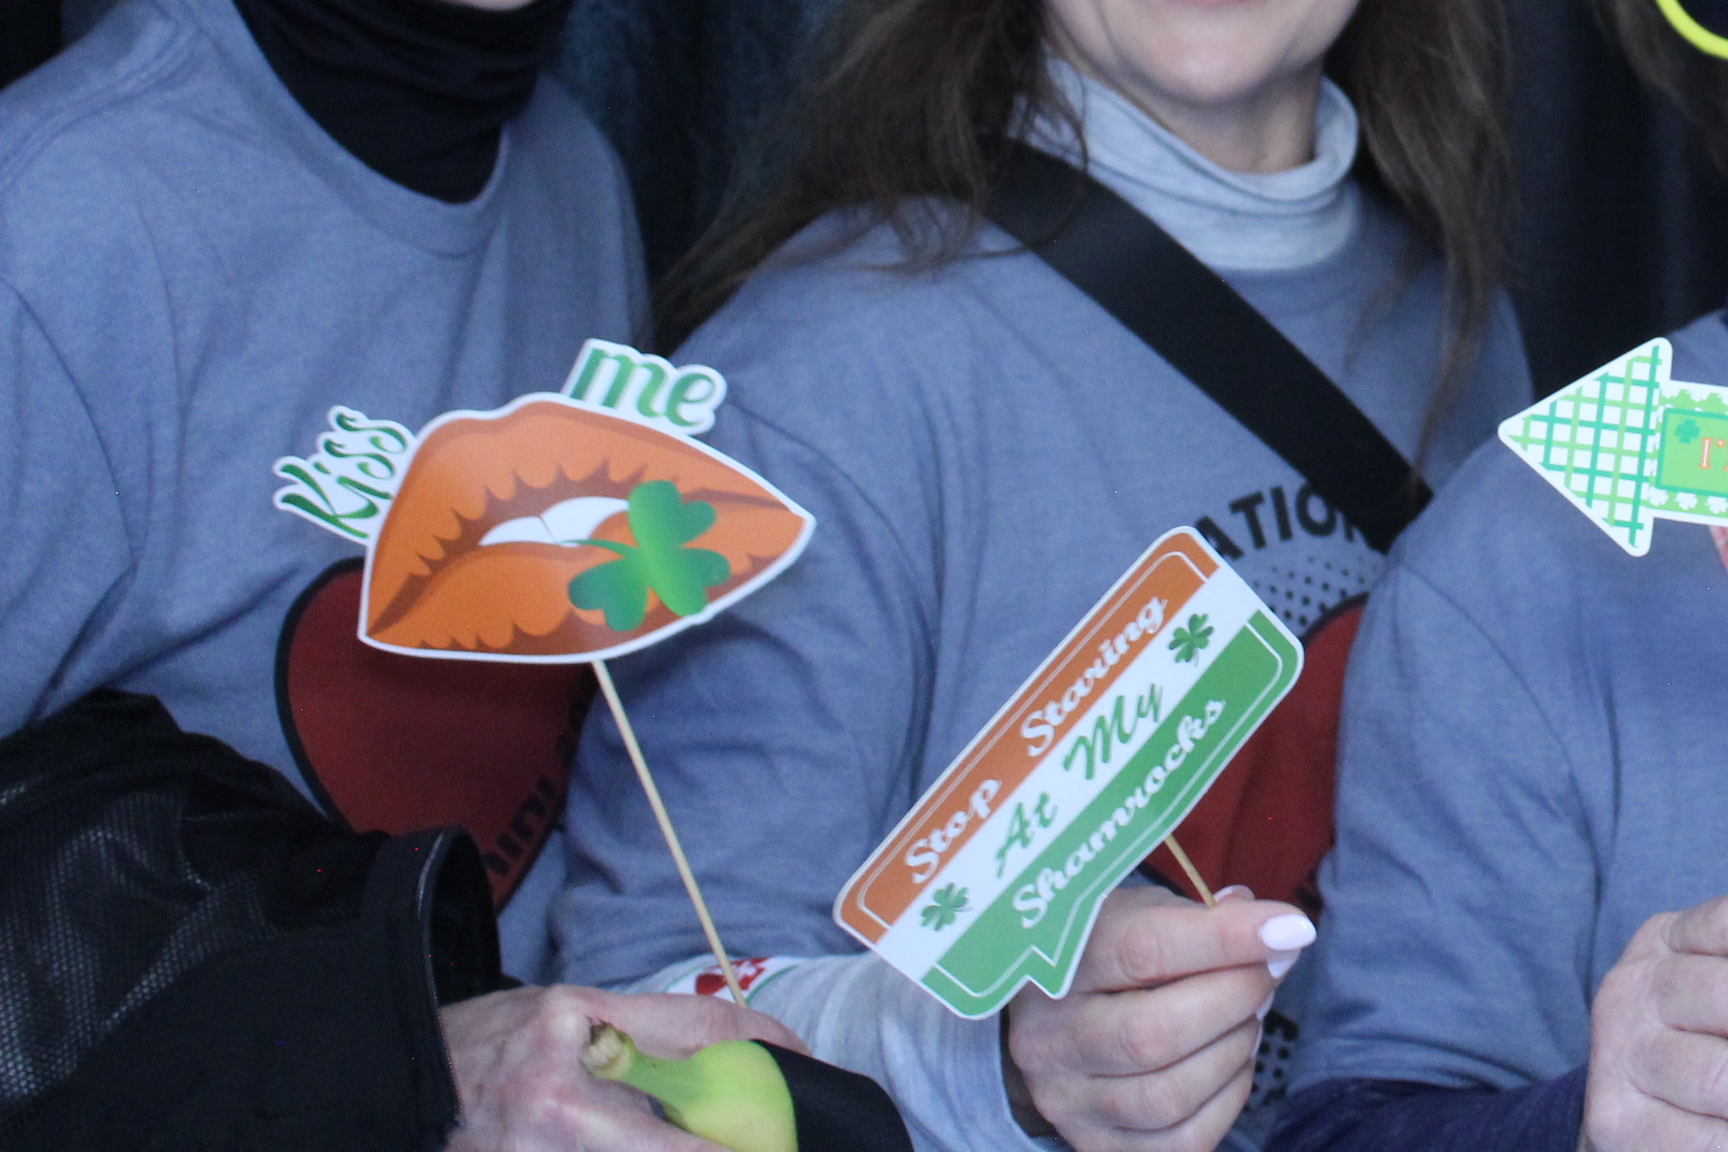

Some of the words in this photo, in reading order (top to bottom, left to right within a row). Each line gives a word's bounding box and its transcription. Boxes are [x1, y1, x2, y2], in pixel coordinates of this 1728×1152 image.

[568, 347, 718, 427] me
[905, 778, 1003, 885] Stop
[1021, 595, 1169, 757] Staring
[996, 791, 1058, 878] At
[1062, 681, 1164, 780] My
[1012, 698, 1226, 929] Shamrocks
